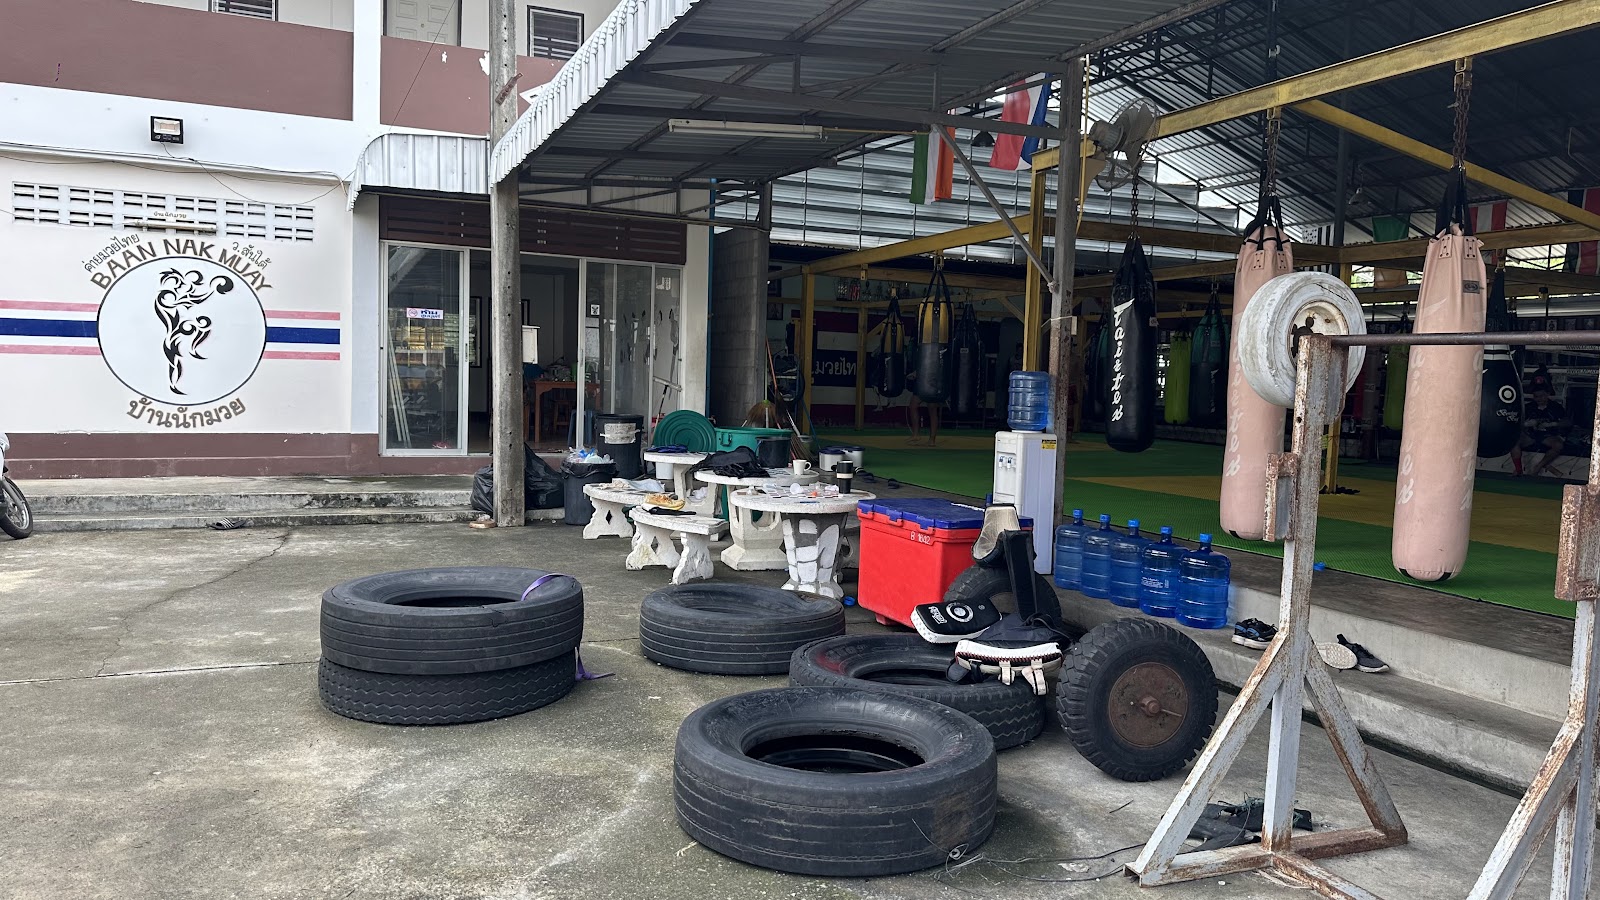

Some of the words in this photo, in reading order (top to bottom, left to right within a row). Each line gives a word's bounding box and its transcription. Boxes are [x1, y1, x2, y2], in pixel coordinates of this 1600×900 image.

[81, 233, 140, 273] ค่ายมวยไทย
[90, 241, 157, 290] BAAN
[163, 238, 216, 260] NAK
[218, 248, 273, 292] MUAY
[1111, 298, 1135, 422] Fairtex
[126, 396, 246, 429] บ้านนักมวย
